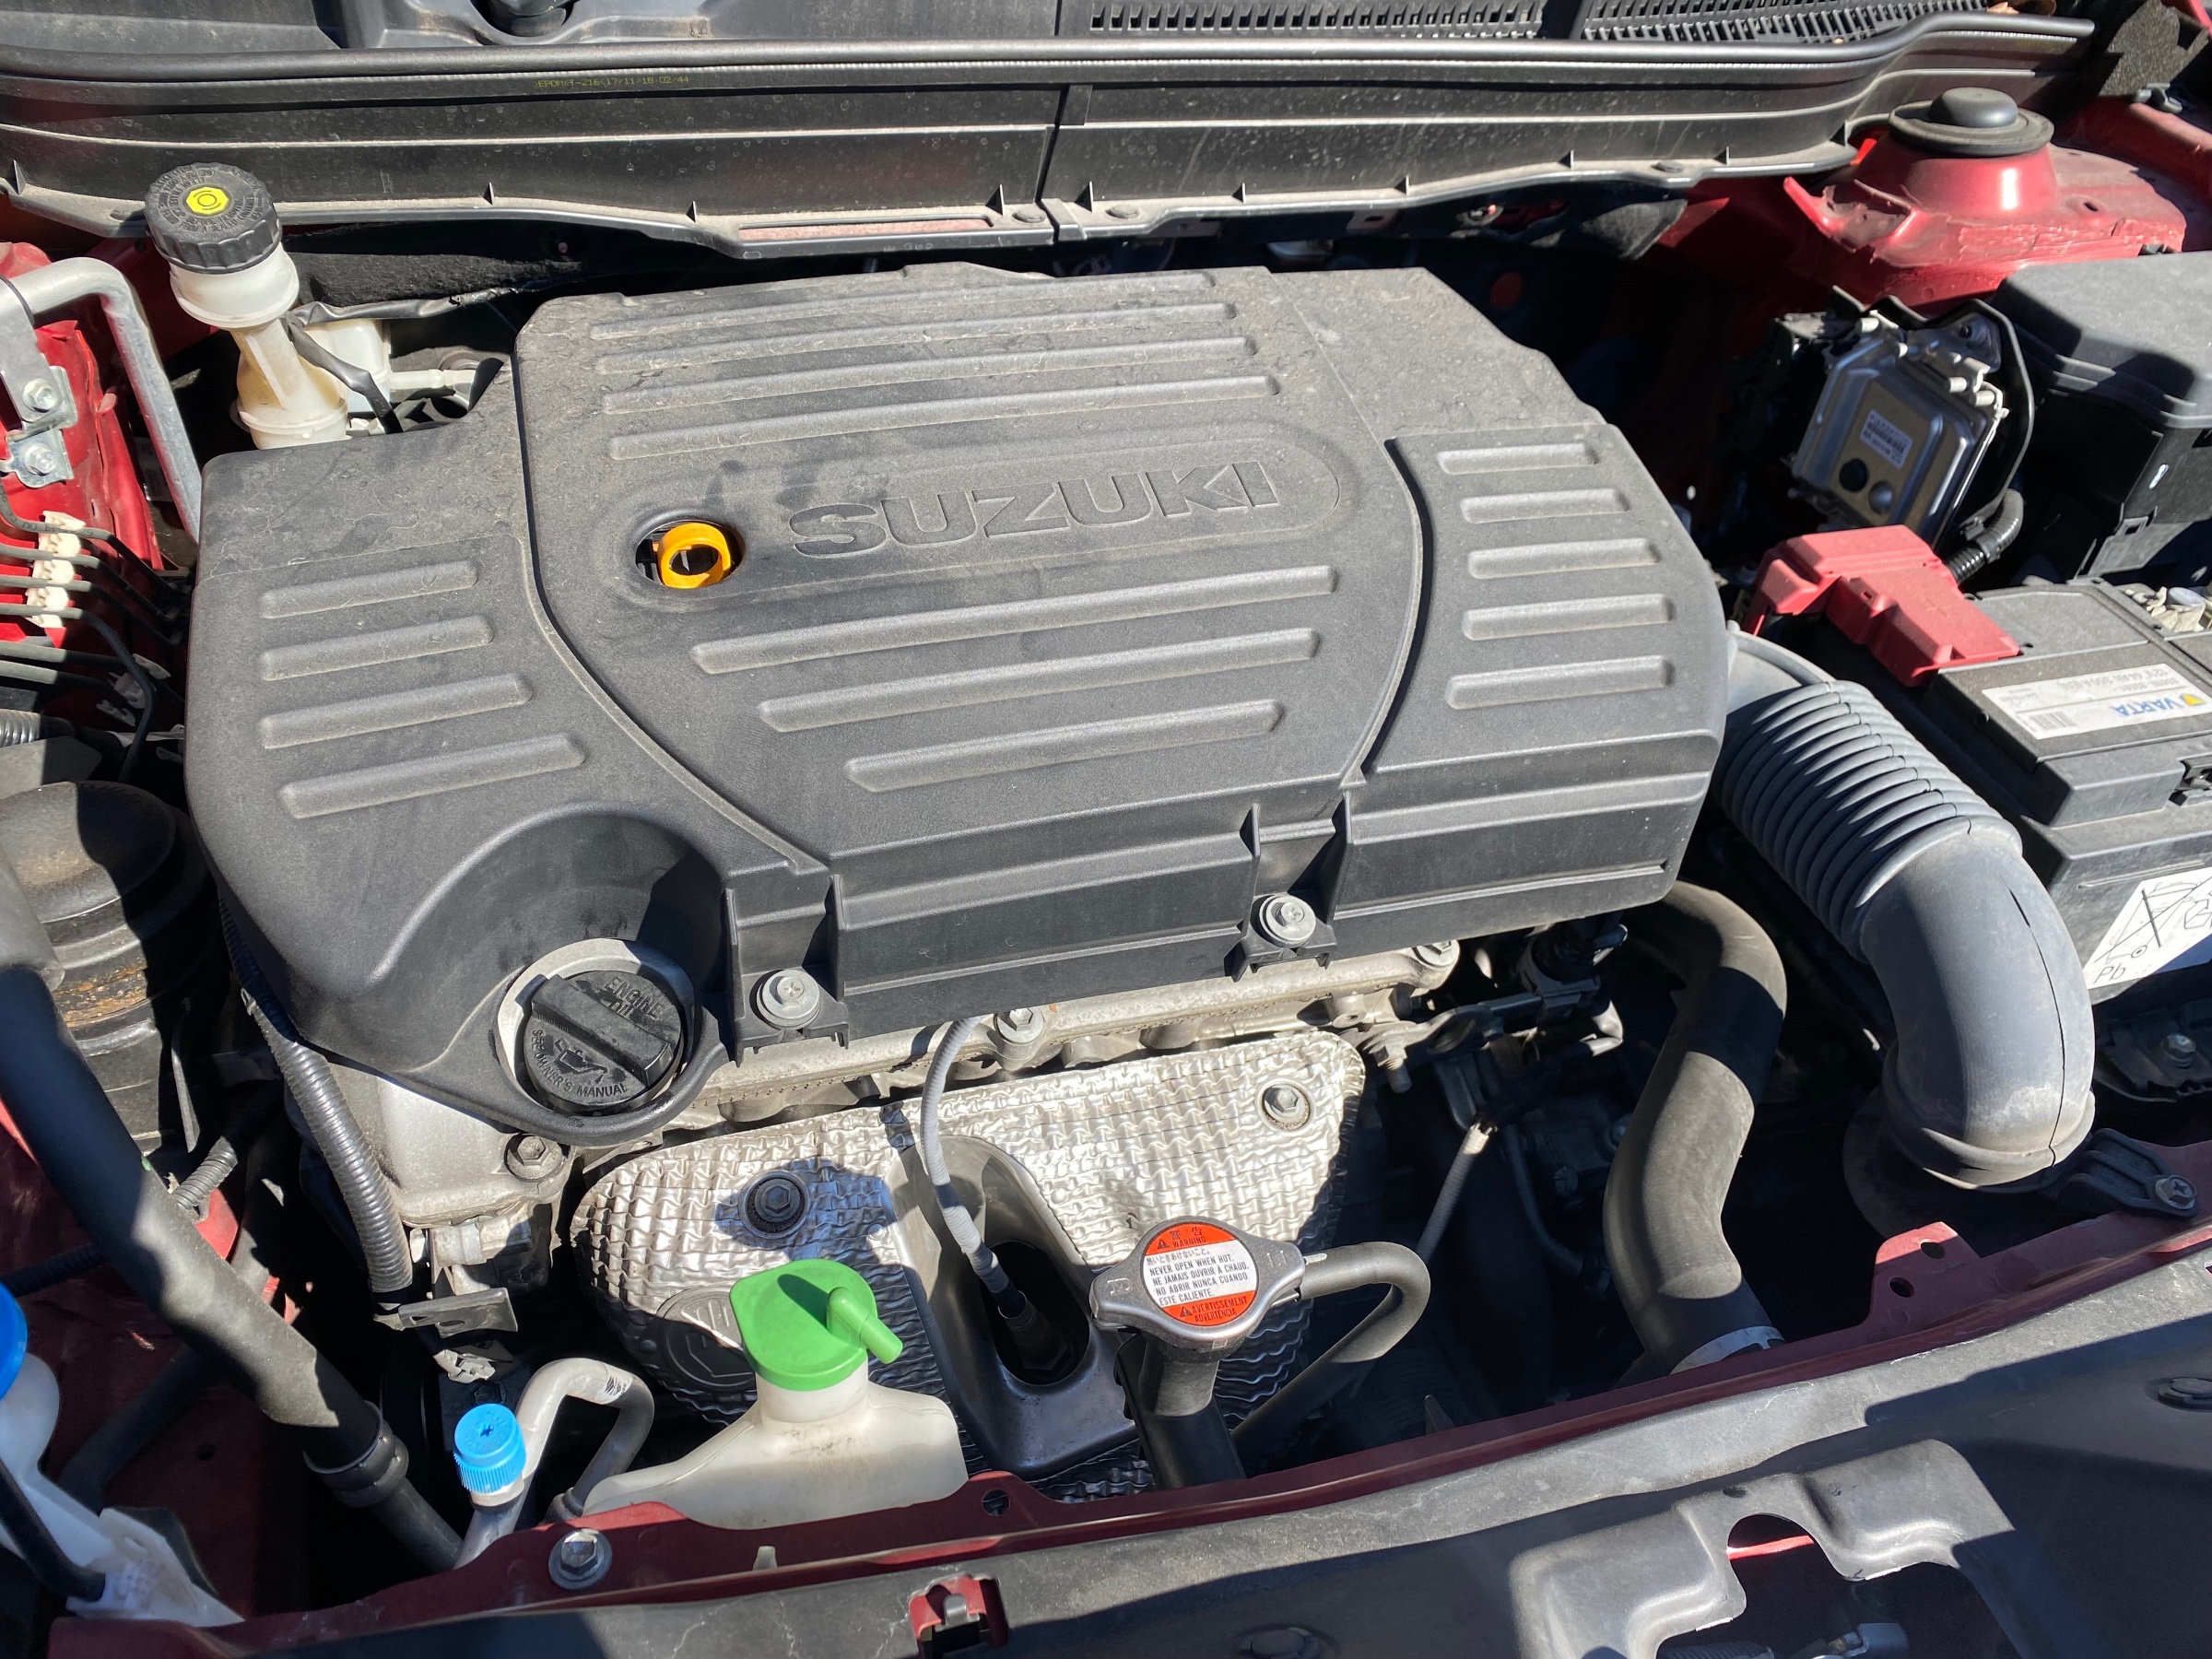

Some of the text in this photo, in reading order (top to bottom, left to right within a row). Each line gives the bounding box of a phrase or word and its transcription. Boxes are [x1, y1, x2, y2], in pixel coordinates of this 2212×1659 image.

[788, 460, 1279, 559] SUZUKI
[2112, 692, 2184, 717] VARTA
[2093, 964, 2126, 985] Pb
[605, 975, 666, 1019] ENGINE
[534, 1052, 574, 1091] OWNER'S
[576, 1082, 629, 1098] MANUAL
[1172, 1236, 1206, 1248] WARNING
[1149, 1253, 1235, 1277] NEVER OPEN WHEN HOT.
[1152, 1277, 1163, 1287] NE
[1164, 1272, 1189, 1284] JAMAIS
[1190, 1266, 1216, 1279] OUVRIR
[1156, 1271, 1248, 1296] NO ABRIR NUNCA CUANDO
[1159, 1288, 1215, 1307] ESTE CALIENTE.
[1192, 1295, 1248, 1314] AVERTISSEMENT
